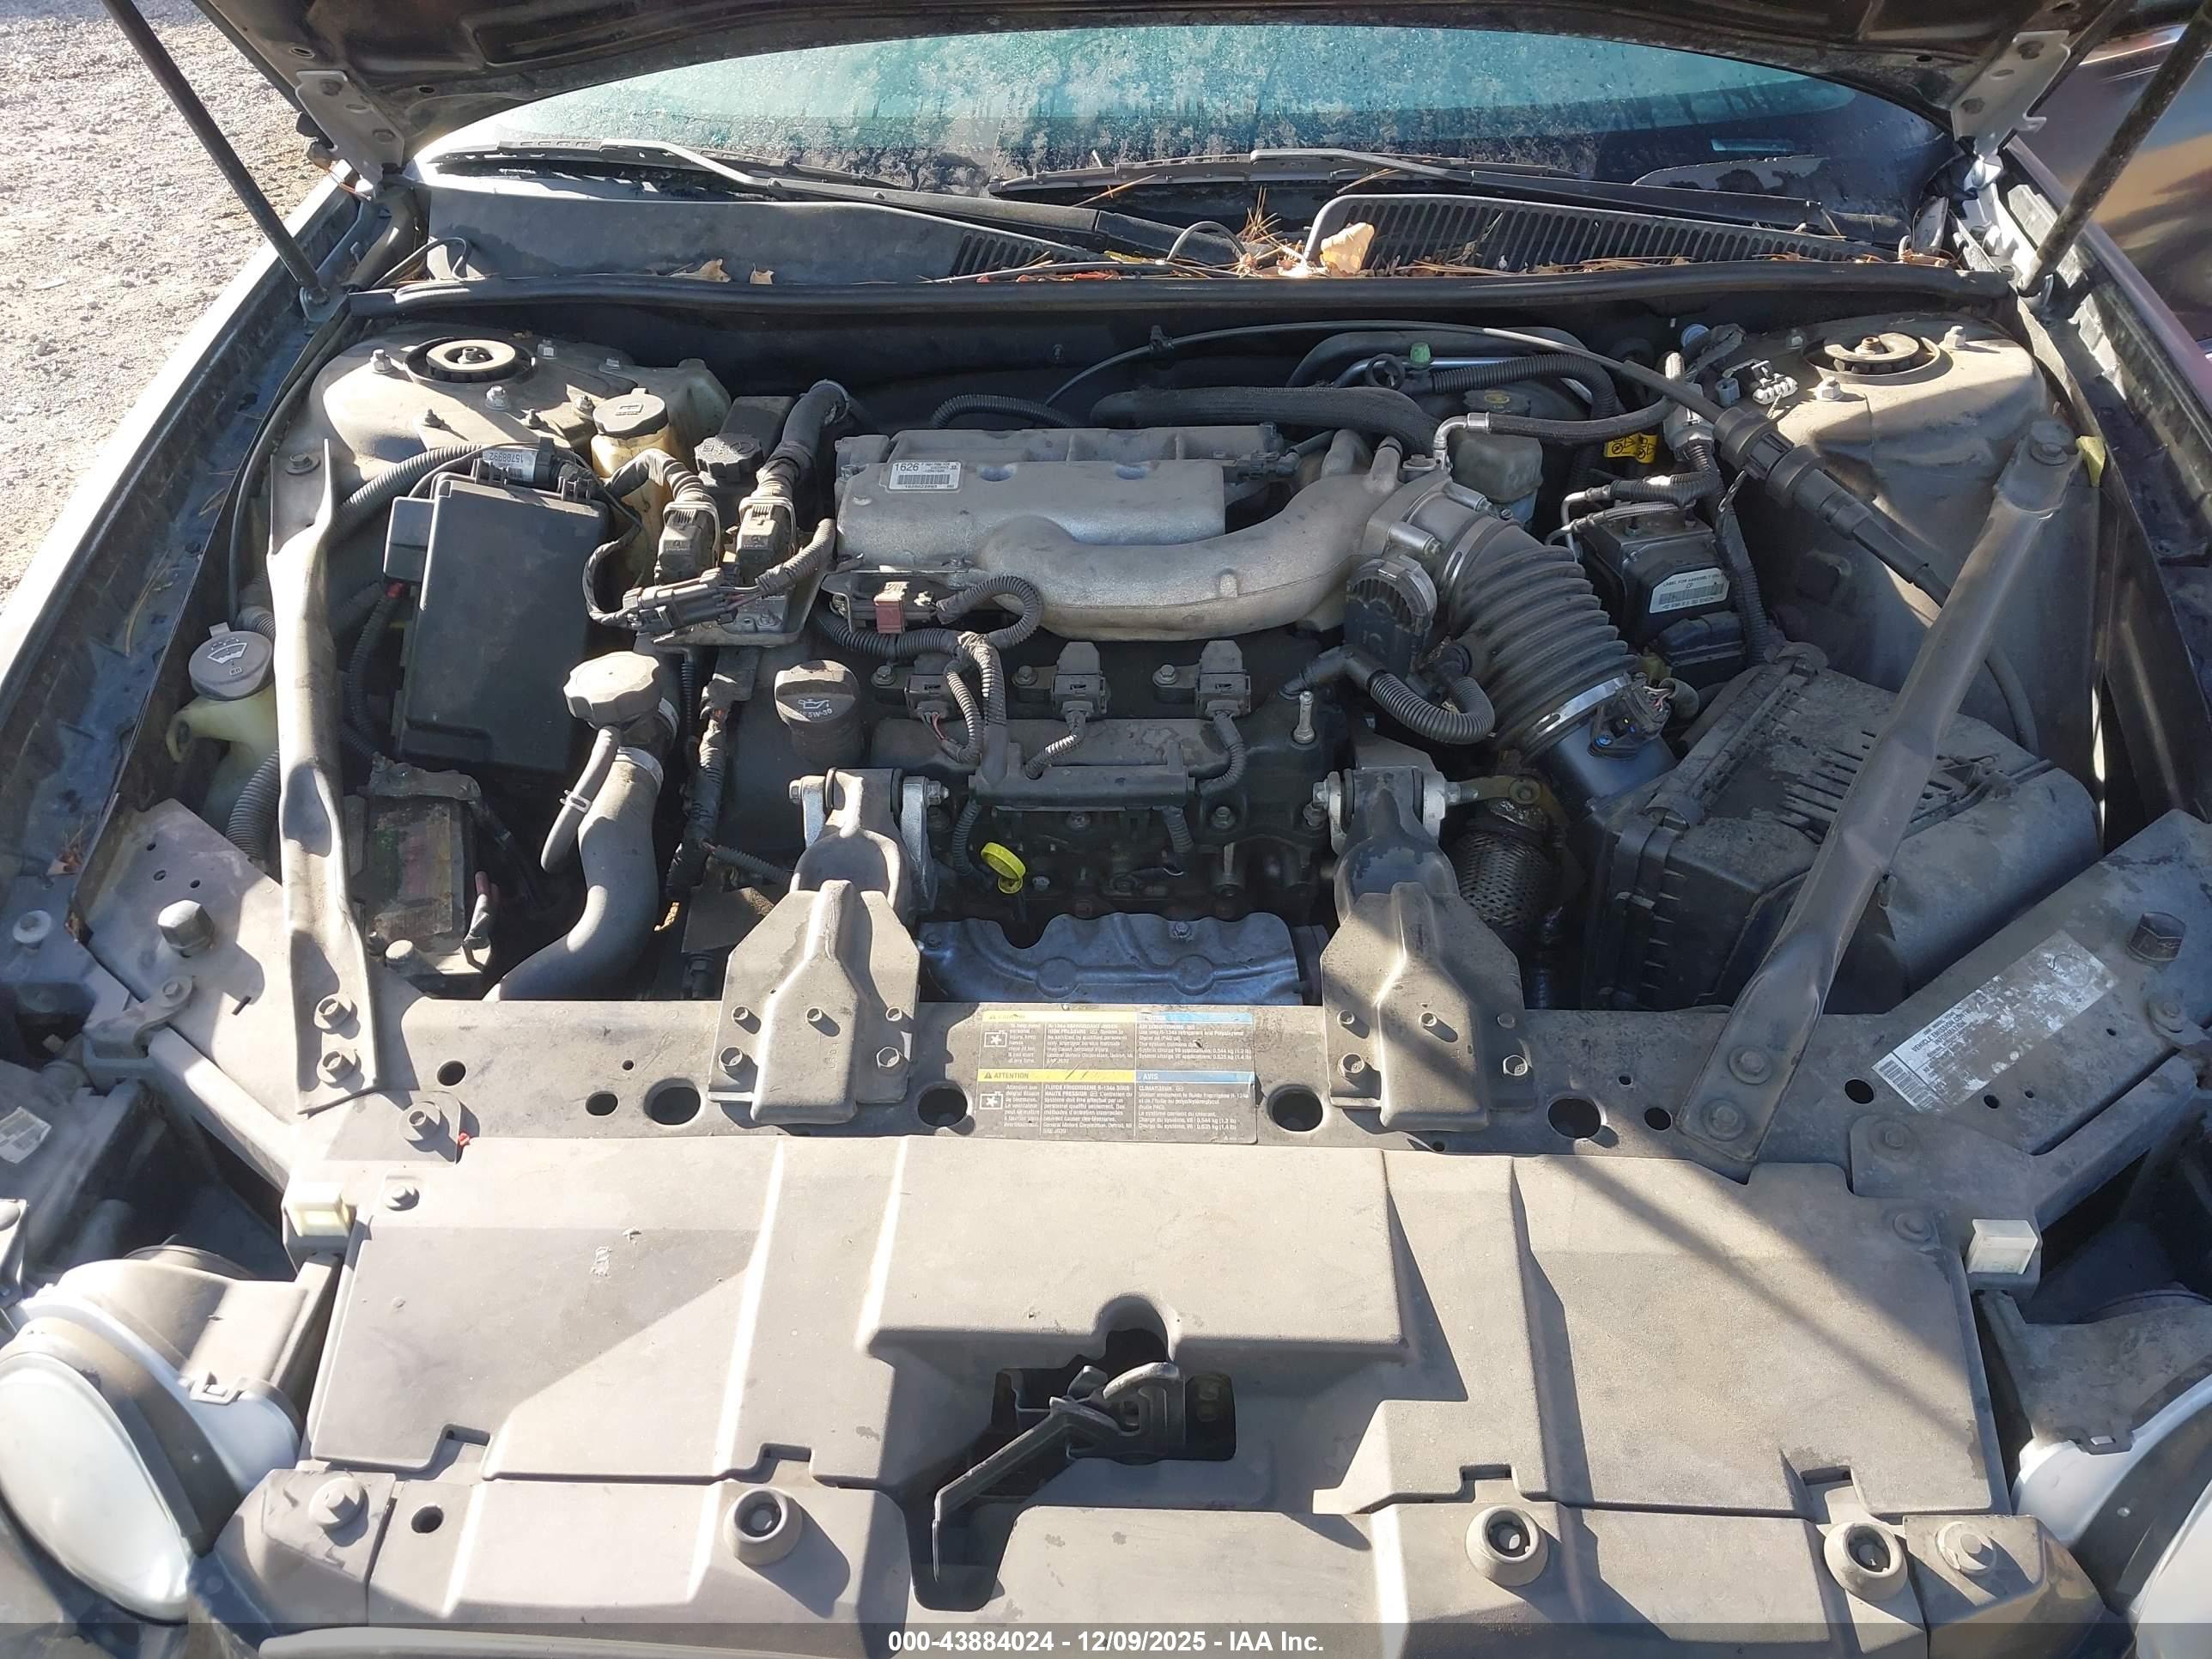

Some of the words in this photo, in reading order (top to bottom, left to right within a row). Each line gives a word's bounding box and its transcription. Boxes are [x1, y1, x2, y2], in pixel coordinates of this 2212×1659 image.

[808, 708, 833, 718] 5W-30
[1911, 1036, 1933, 1052] VEHICLE
[1931, 1019, 1954, 1038] EMISSION
[1934, 1020, 1966, 1045] INFORMATION
